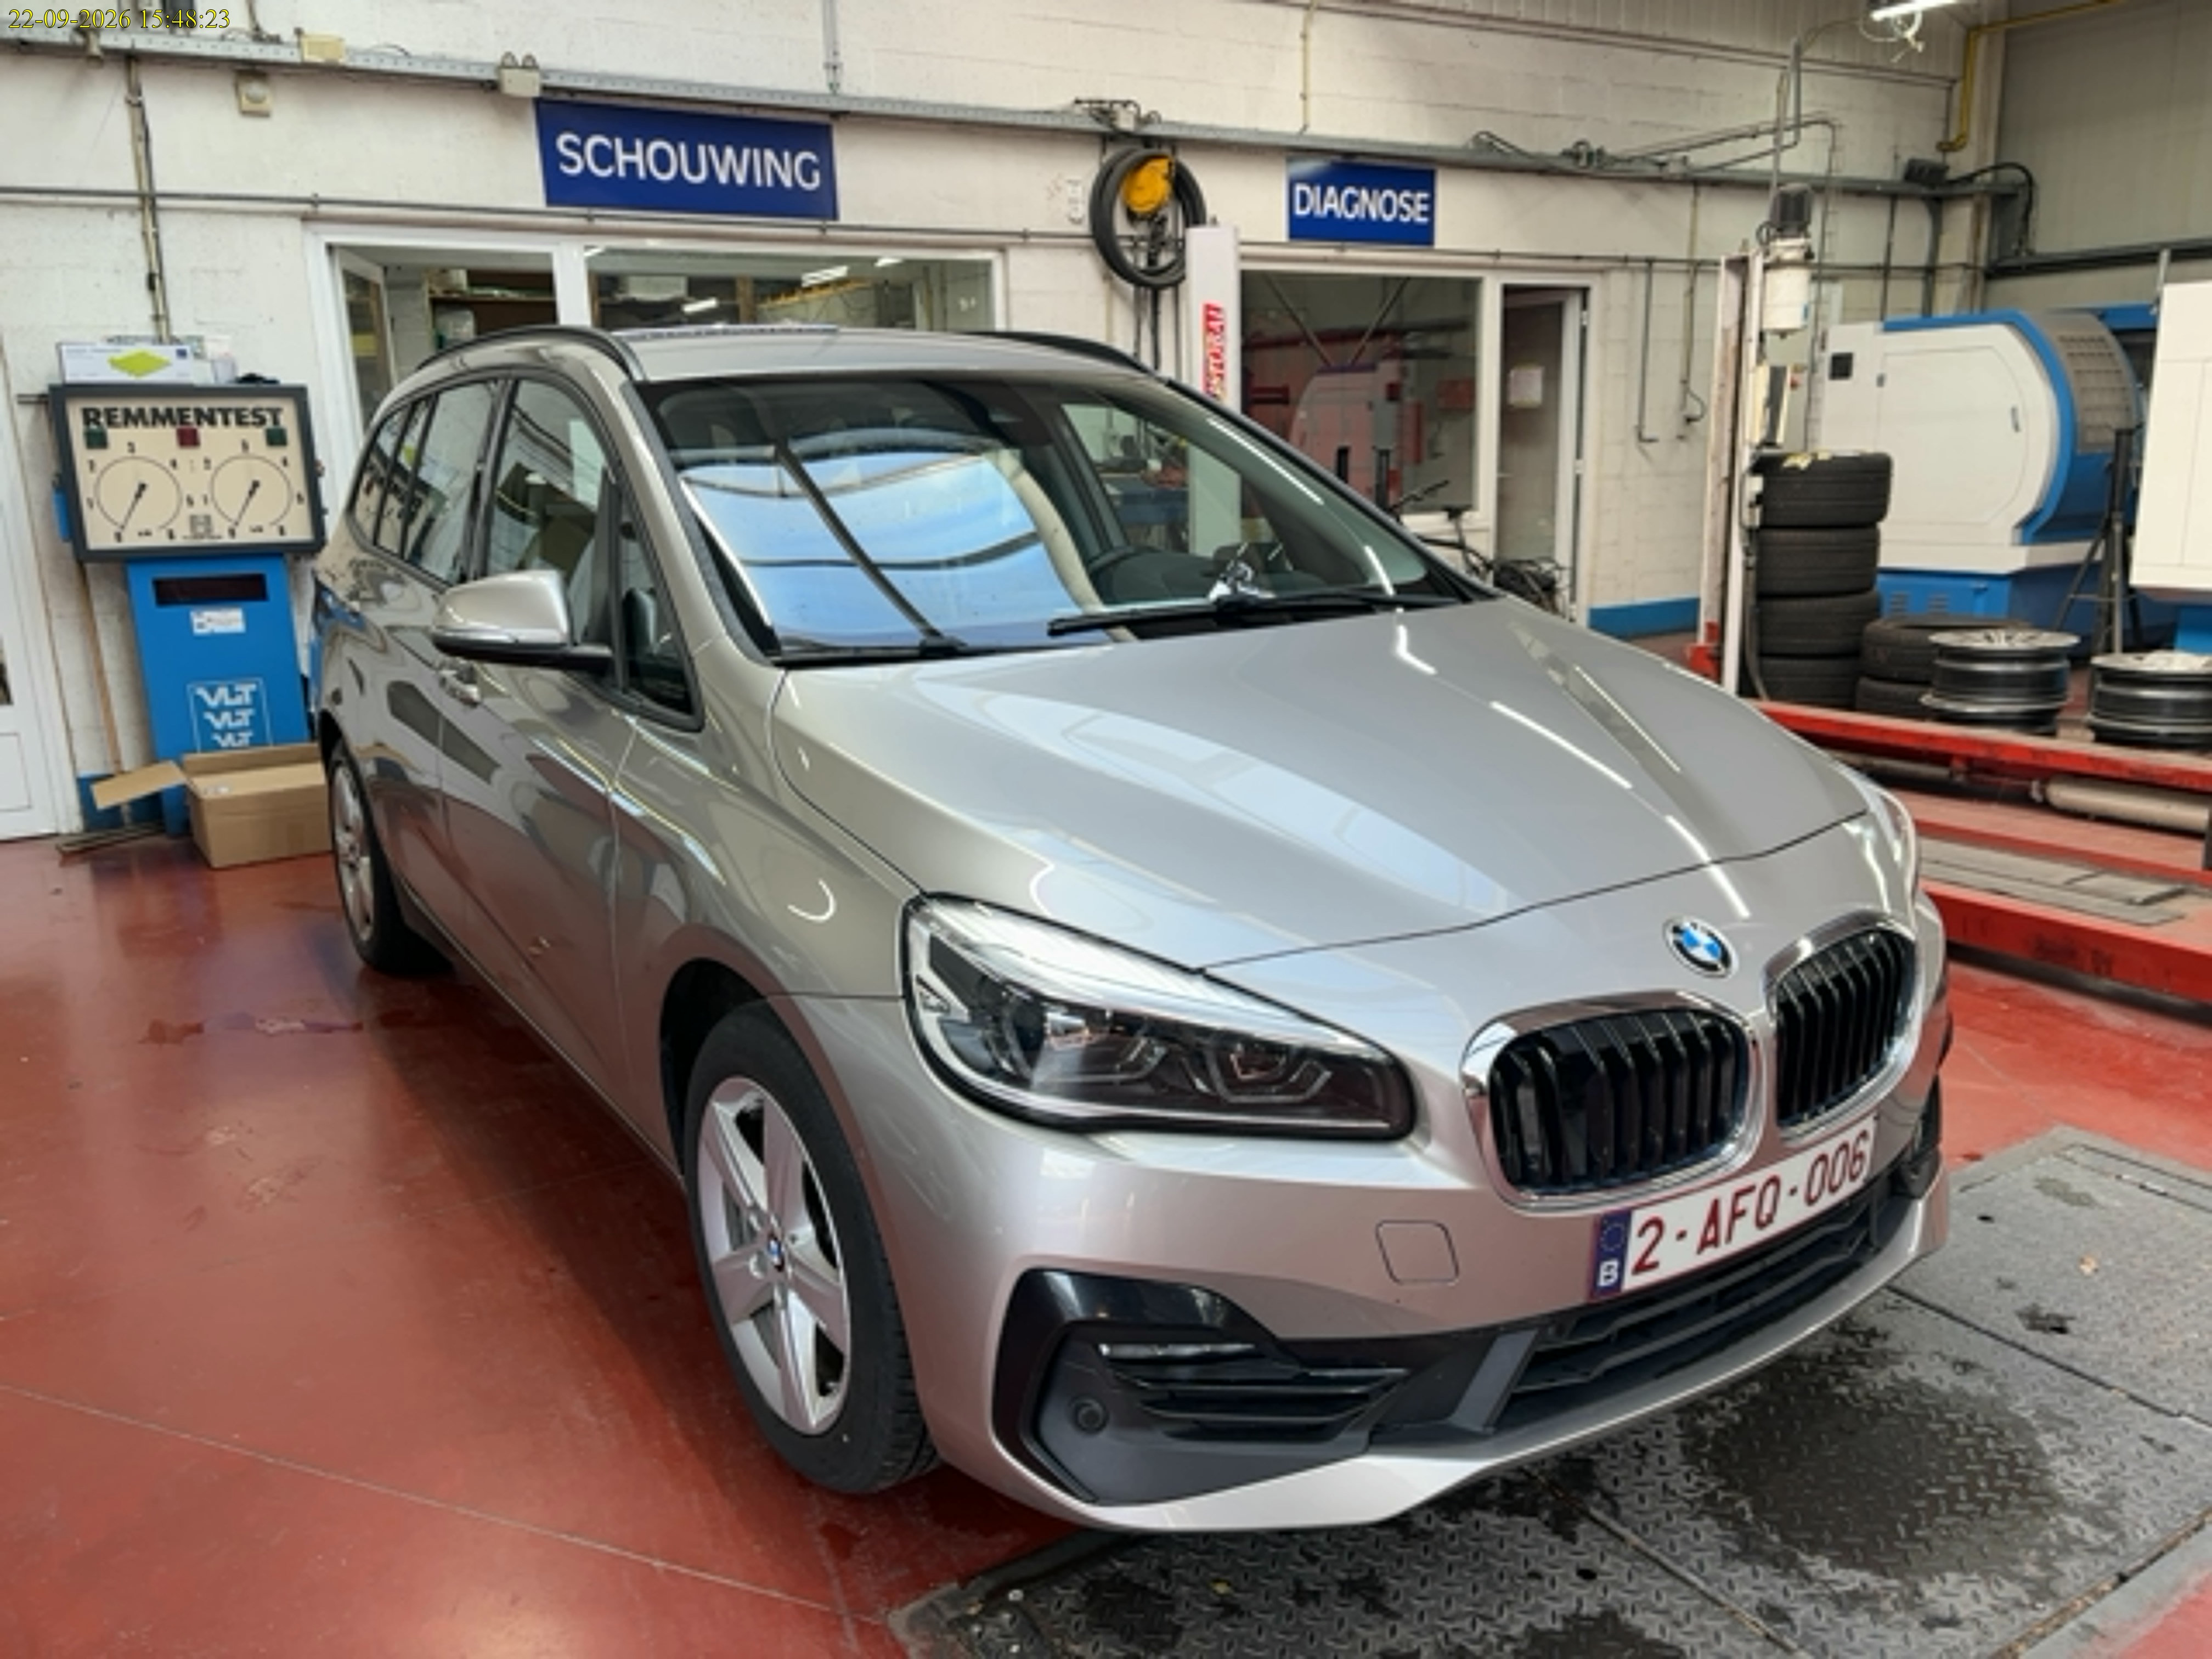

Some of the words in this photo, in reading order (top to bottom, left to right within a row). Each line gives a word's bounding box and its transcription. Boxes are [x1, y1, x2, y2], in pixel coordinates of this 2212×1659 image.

[555, 131, 821, 191] SCHOUWING
[1294, 182, 1430, 223] DIAGNOSE
[81, 407, 283, 428] REMMENTEST
[195, 684, 256, 708] VLT
[203, 708, 255, 730] VLT
[1597, 1260, 1619, 1288] B
